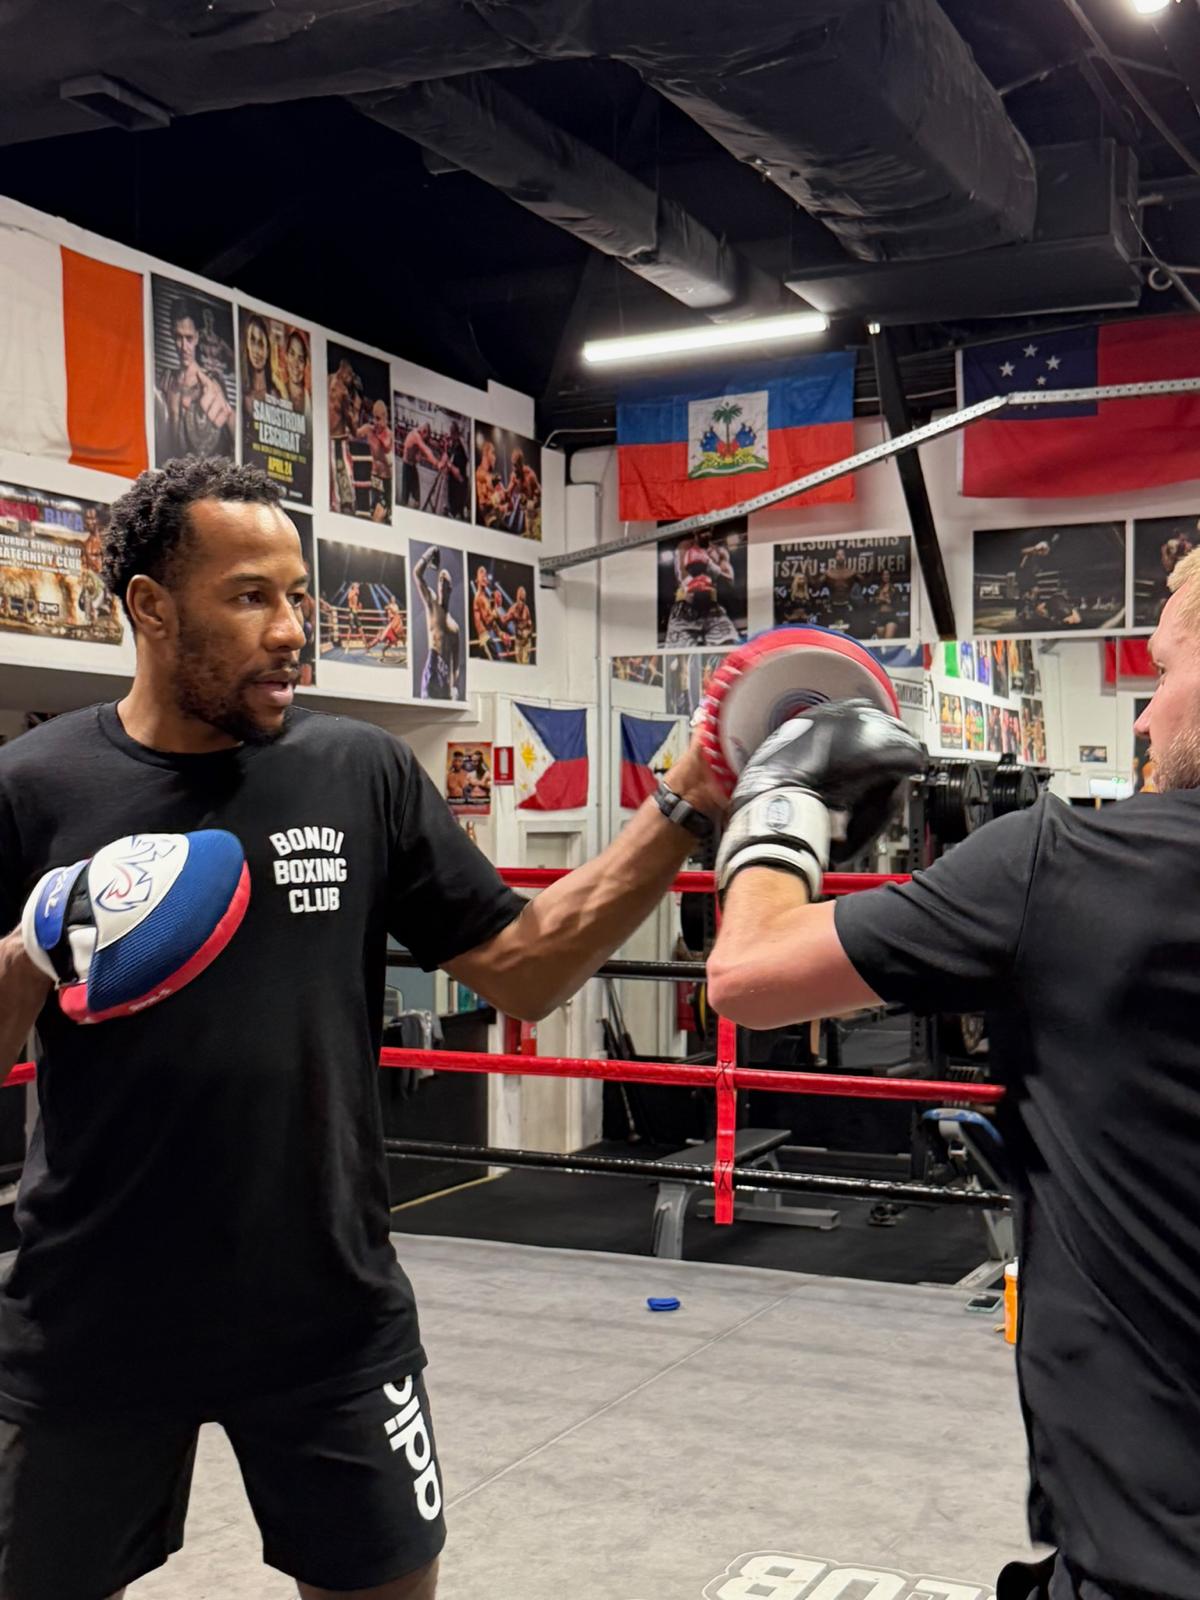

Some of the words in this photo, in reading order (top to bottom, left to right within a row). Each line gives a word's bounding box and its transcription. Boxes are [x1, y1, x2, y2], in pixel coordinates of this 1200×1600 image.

[780, 540, 836, 552] WILSON
[846, 536, 898, 549] ALANIS
[56, 555, 80, 569] CLUB
[774, 558, 818, 577] TSZYU
[828, 554, 906, 574] BUBAKER
[269, 826, 344, 857] BONDI
[273, 858, 347, 885] BOXING
[289, 887, 340, 913] CLUB
